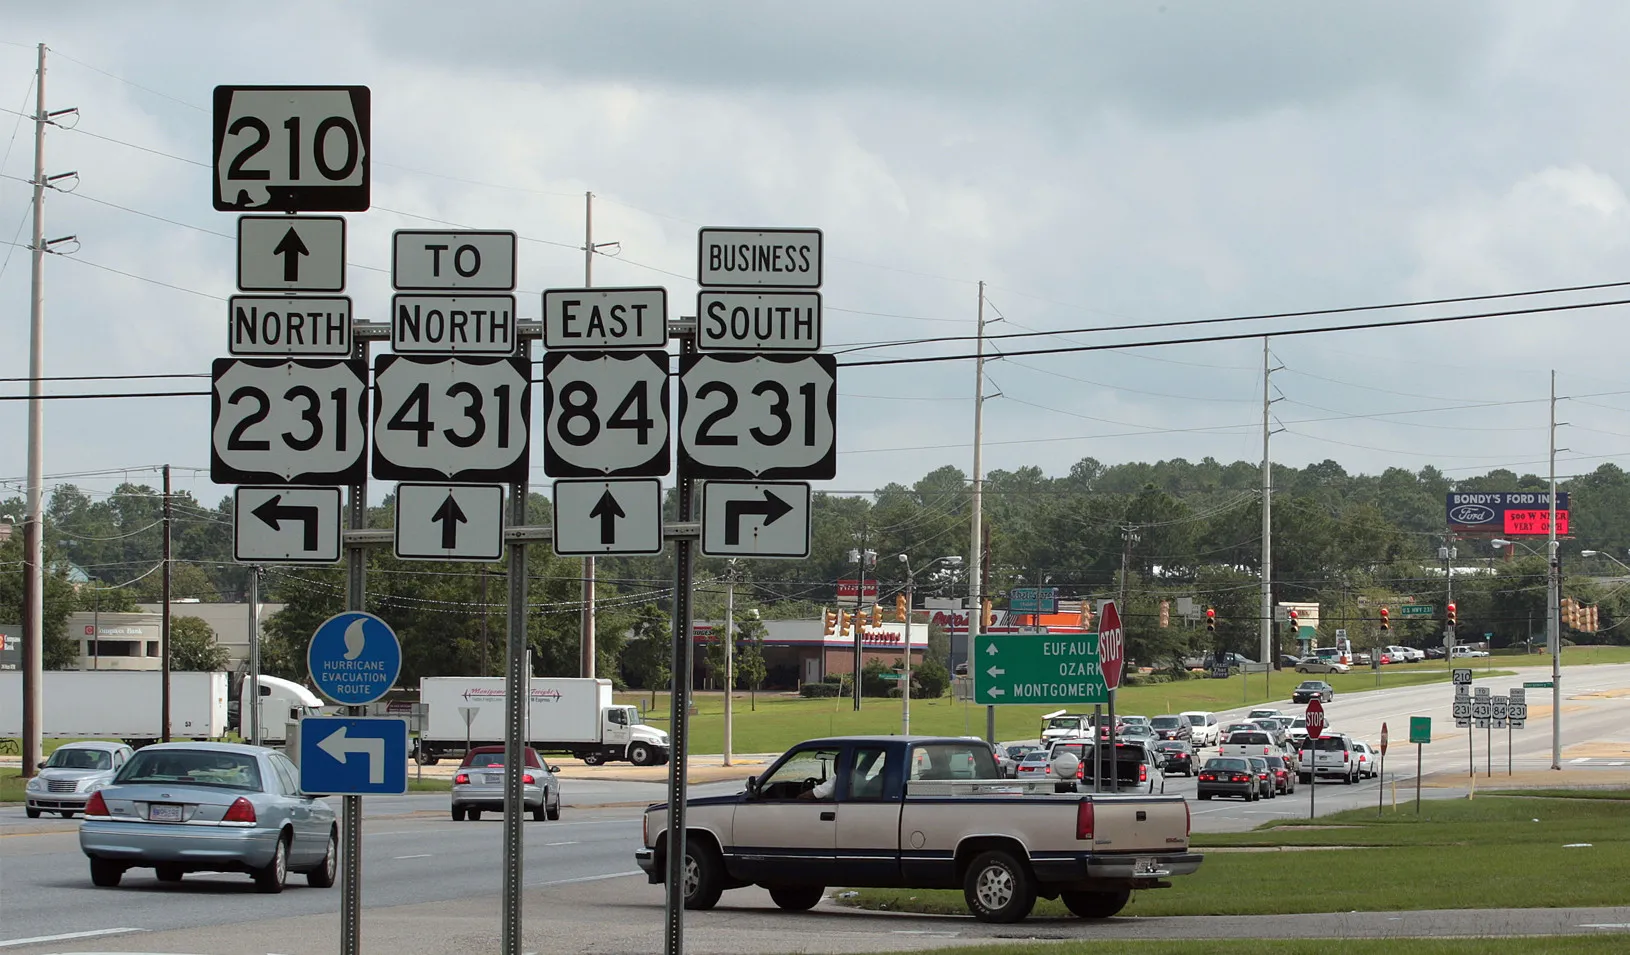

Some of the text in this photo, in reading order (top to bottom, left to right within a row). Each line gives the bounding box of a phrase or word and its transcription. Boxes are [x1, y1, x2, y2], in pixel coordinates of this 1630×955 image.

[227, 116, 359, 181] 210
[424, 243, 482, 278] TO
[709, 244, 811, 273] BUSINESS
[235, 305, 345, 346] NORTH
[398, 304, 509, 344] NORTH
[562, 300, 648, 338] EAST
[705, 300, 813, 341] SOUTH
[227, 386, 347, 452] 231
[386, 381, 510, 450] 431
[556, 380, 654, 447] 84
[694, 380, 816, 447] 231
[1453, 493, 1561, 504] BONDY'S FORD IN.
[1458, 507, 1485, 520] Ford
[839, 584, 875, 592] Firesone
[1100, 628, 1121, 664] STOP
[324, 660, 385, 671] HURRICANE
[1059, 663, 1104, 677] OZARK
[322, 672, 387, 682] EVACUATION
[1454, 673, 1471, 682] 210
[337, 684, 371, 694] ROUTE
[1013, 683, 1104, 697] MONTGOMERY
[1455, 705, 1470, 714] 231
[1474, 706, 1490, 715] 431
[1493, 706, 1506, 716] 84
[1509, 706, 1525, 716] 231
[1306, 711, 1324, 727] STOP
